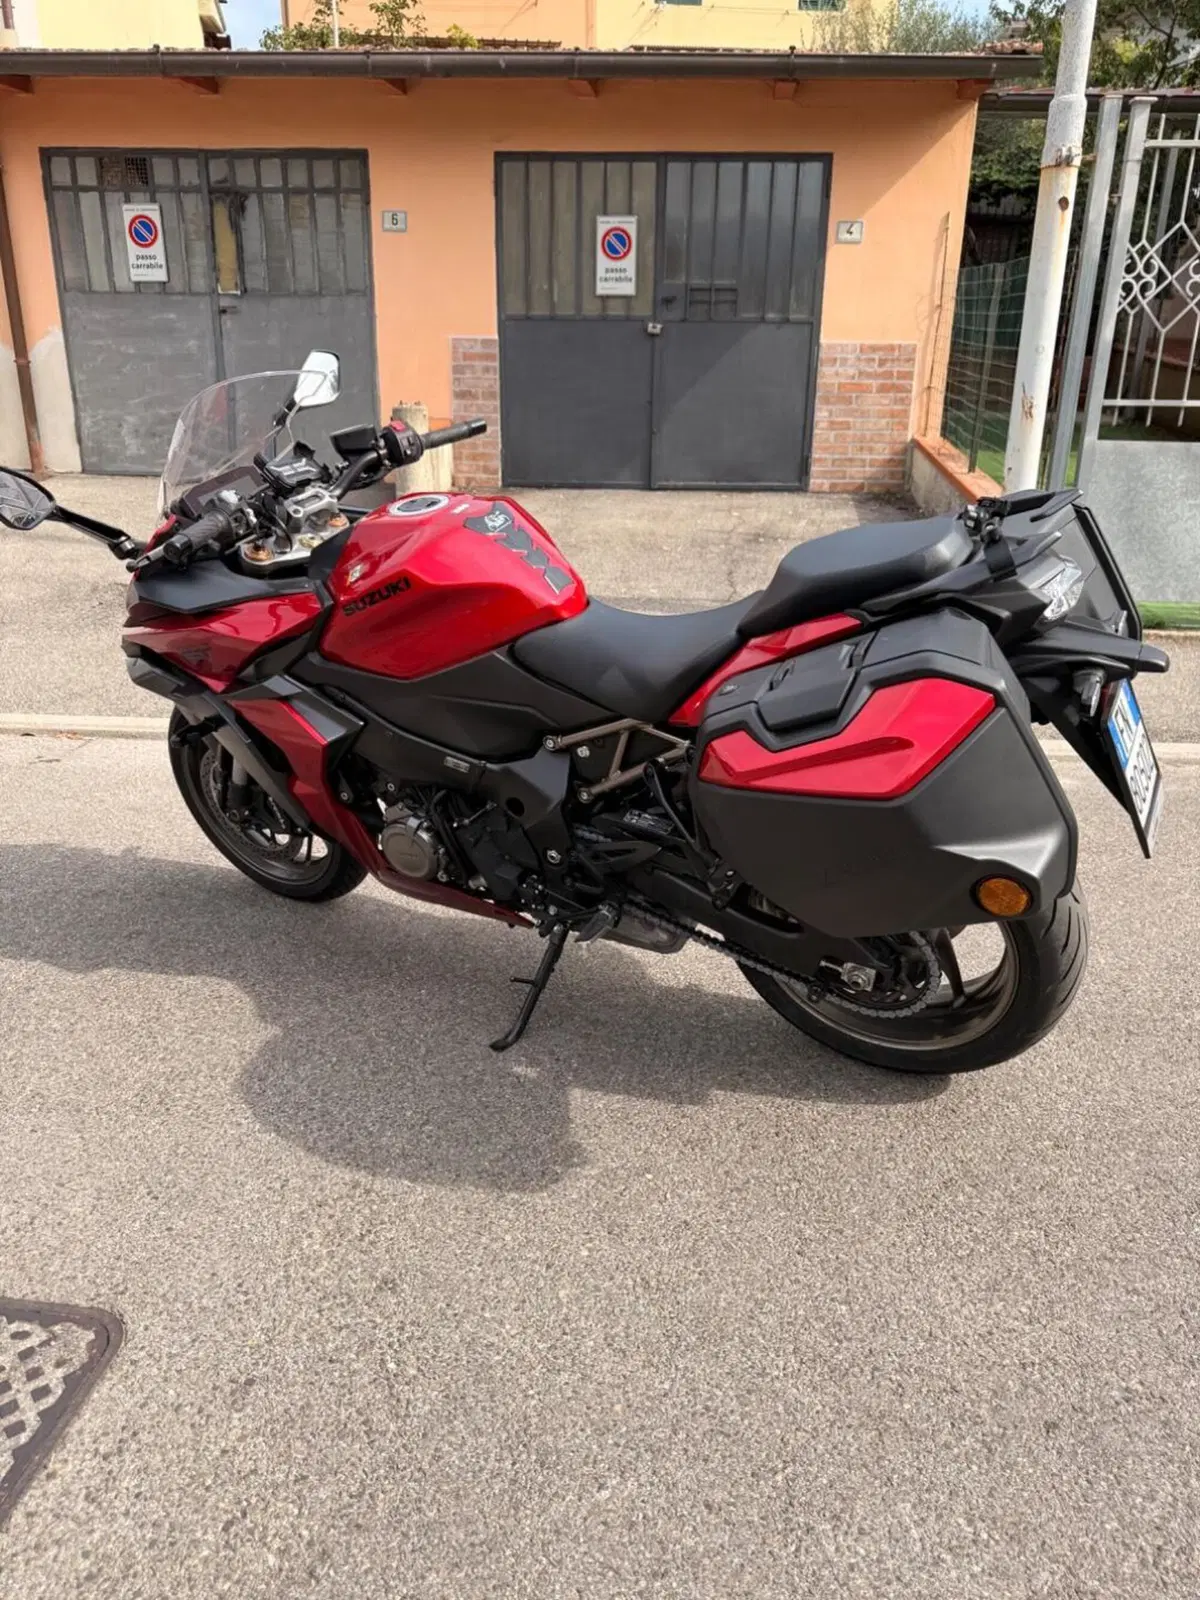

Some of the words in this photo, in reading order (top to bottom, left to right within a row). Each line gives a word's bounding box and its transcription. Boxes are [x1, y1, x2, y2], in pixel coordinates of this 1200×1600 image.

[391, 212, 399, 226] 6
[846, 223, 854, 236] 4
[135, 253, 158, 261] passo
[131, 262, 163, 270] carrabile
[604, 267, 628, 275] passo
[343, 576, 411, 616] SUZUKI
